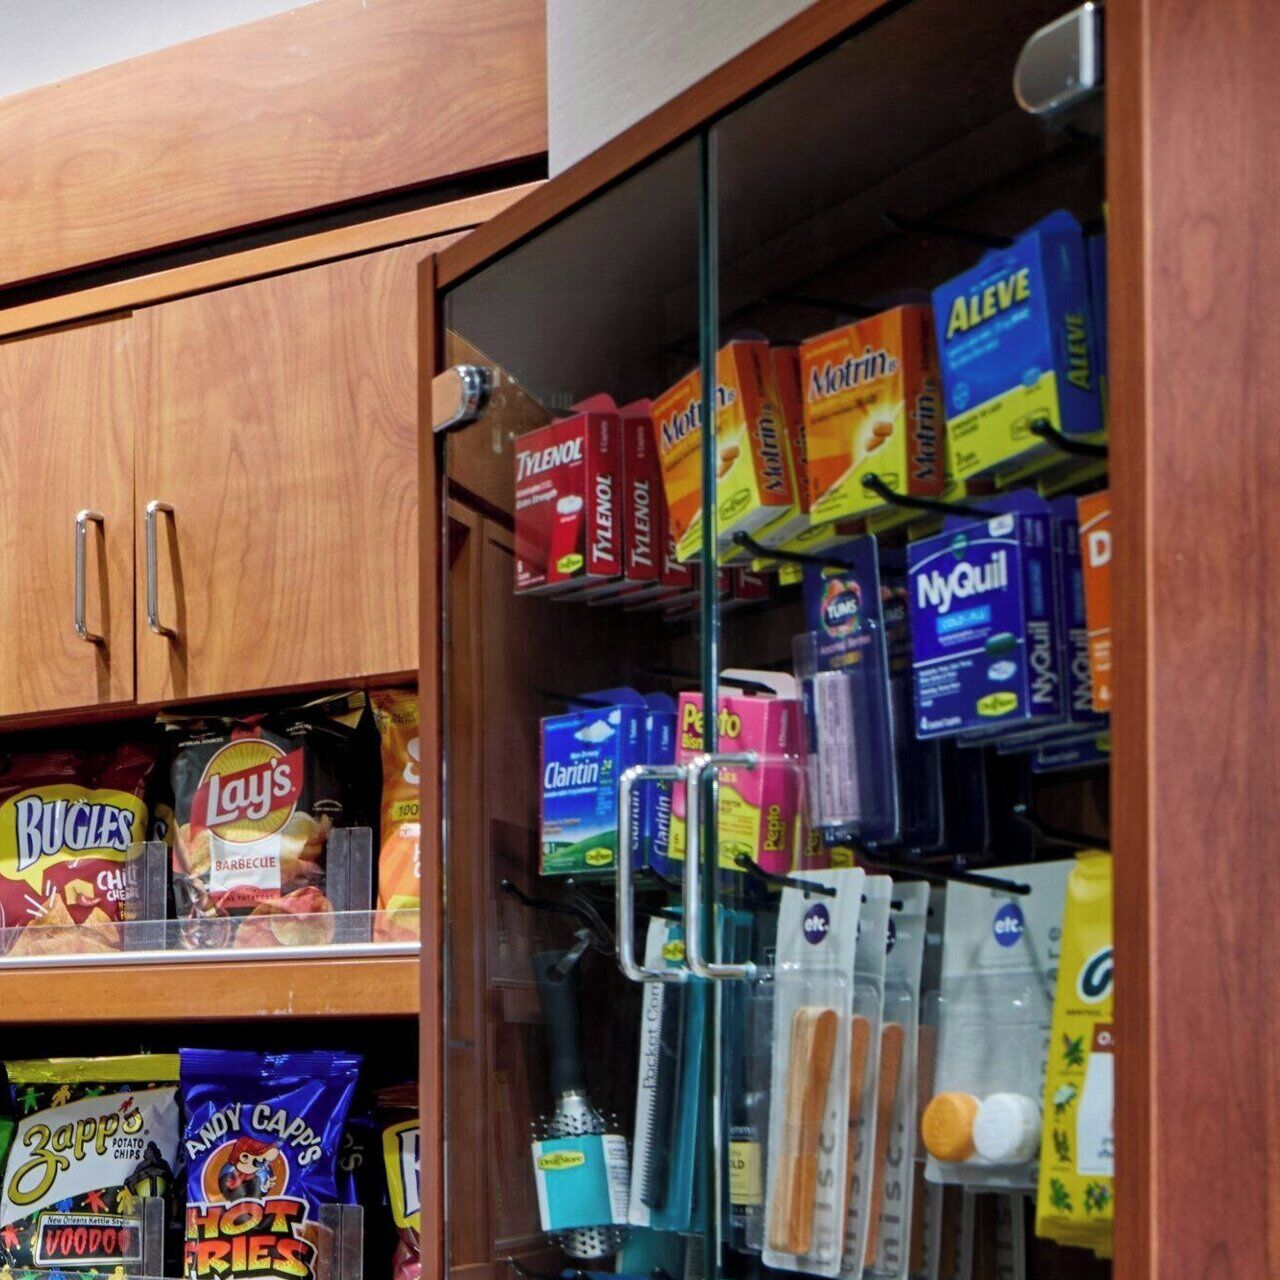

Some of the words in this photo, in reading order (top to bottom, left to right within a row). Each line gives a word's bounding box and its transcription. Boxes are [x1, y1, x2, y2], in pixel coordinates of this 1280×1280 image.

[947, 267, 1031, 341] ALEVE
[808, 349, 888, 405] Motrin
[1067, 312, 1091, 391] ALEVE
[517, 436, 586, 483] TYLENOL
[764, 414, 787, 498] Motrin
[913, 393, 939, 482] Motrin
[592, 474, 616, 563] TYLENOL
[632, 479, 654, 568] TYLENOL
[916, 550, 1008, 614] NyQuil
[827, 601, 858, 620] TUMS
[1030, 621, 1055, 703] NyQuil
[206, 756, 292, 829] Lay's
[544, 761, 600, 788] Claritin
[15, 795, 134, 873] BUGLES
[764, 804, 781, 851] Pepto
[215, 857, 277, 871] BARBECUE
[803, 917, 829, 936] etc.
[993, 917, 1023, 936] etc.
[643, 1028, 661, 1090] Pocket
[7, 1106, 145, 1206] Zapp's
[112, 1140, 145, 1152] POTATO
[113, 1152, 141, 1164] CHIPS
[185, 1103, 242, 1161] ANDY
[251, 1102, 324, 1167] CAPP'S
[45, 1227, 132, 1256] VOODOO
[47, 1215, 62, 1226] New
[63, 1216, 90, 1227] Orleans
[185, 1199, 301, 1239] HOT
[185, 1235, 311, 1278] FRIES
